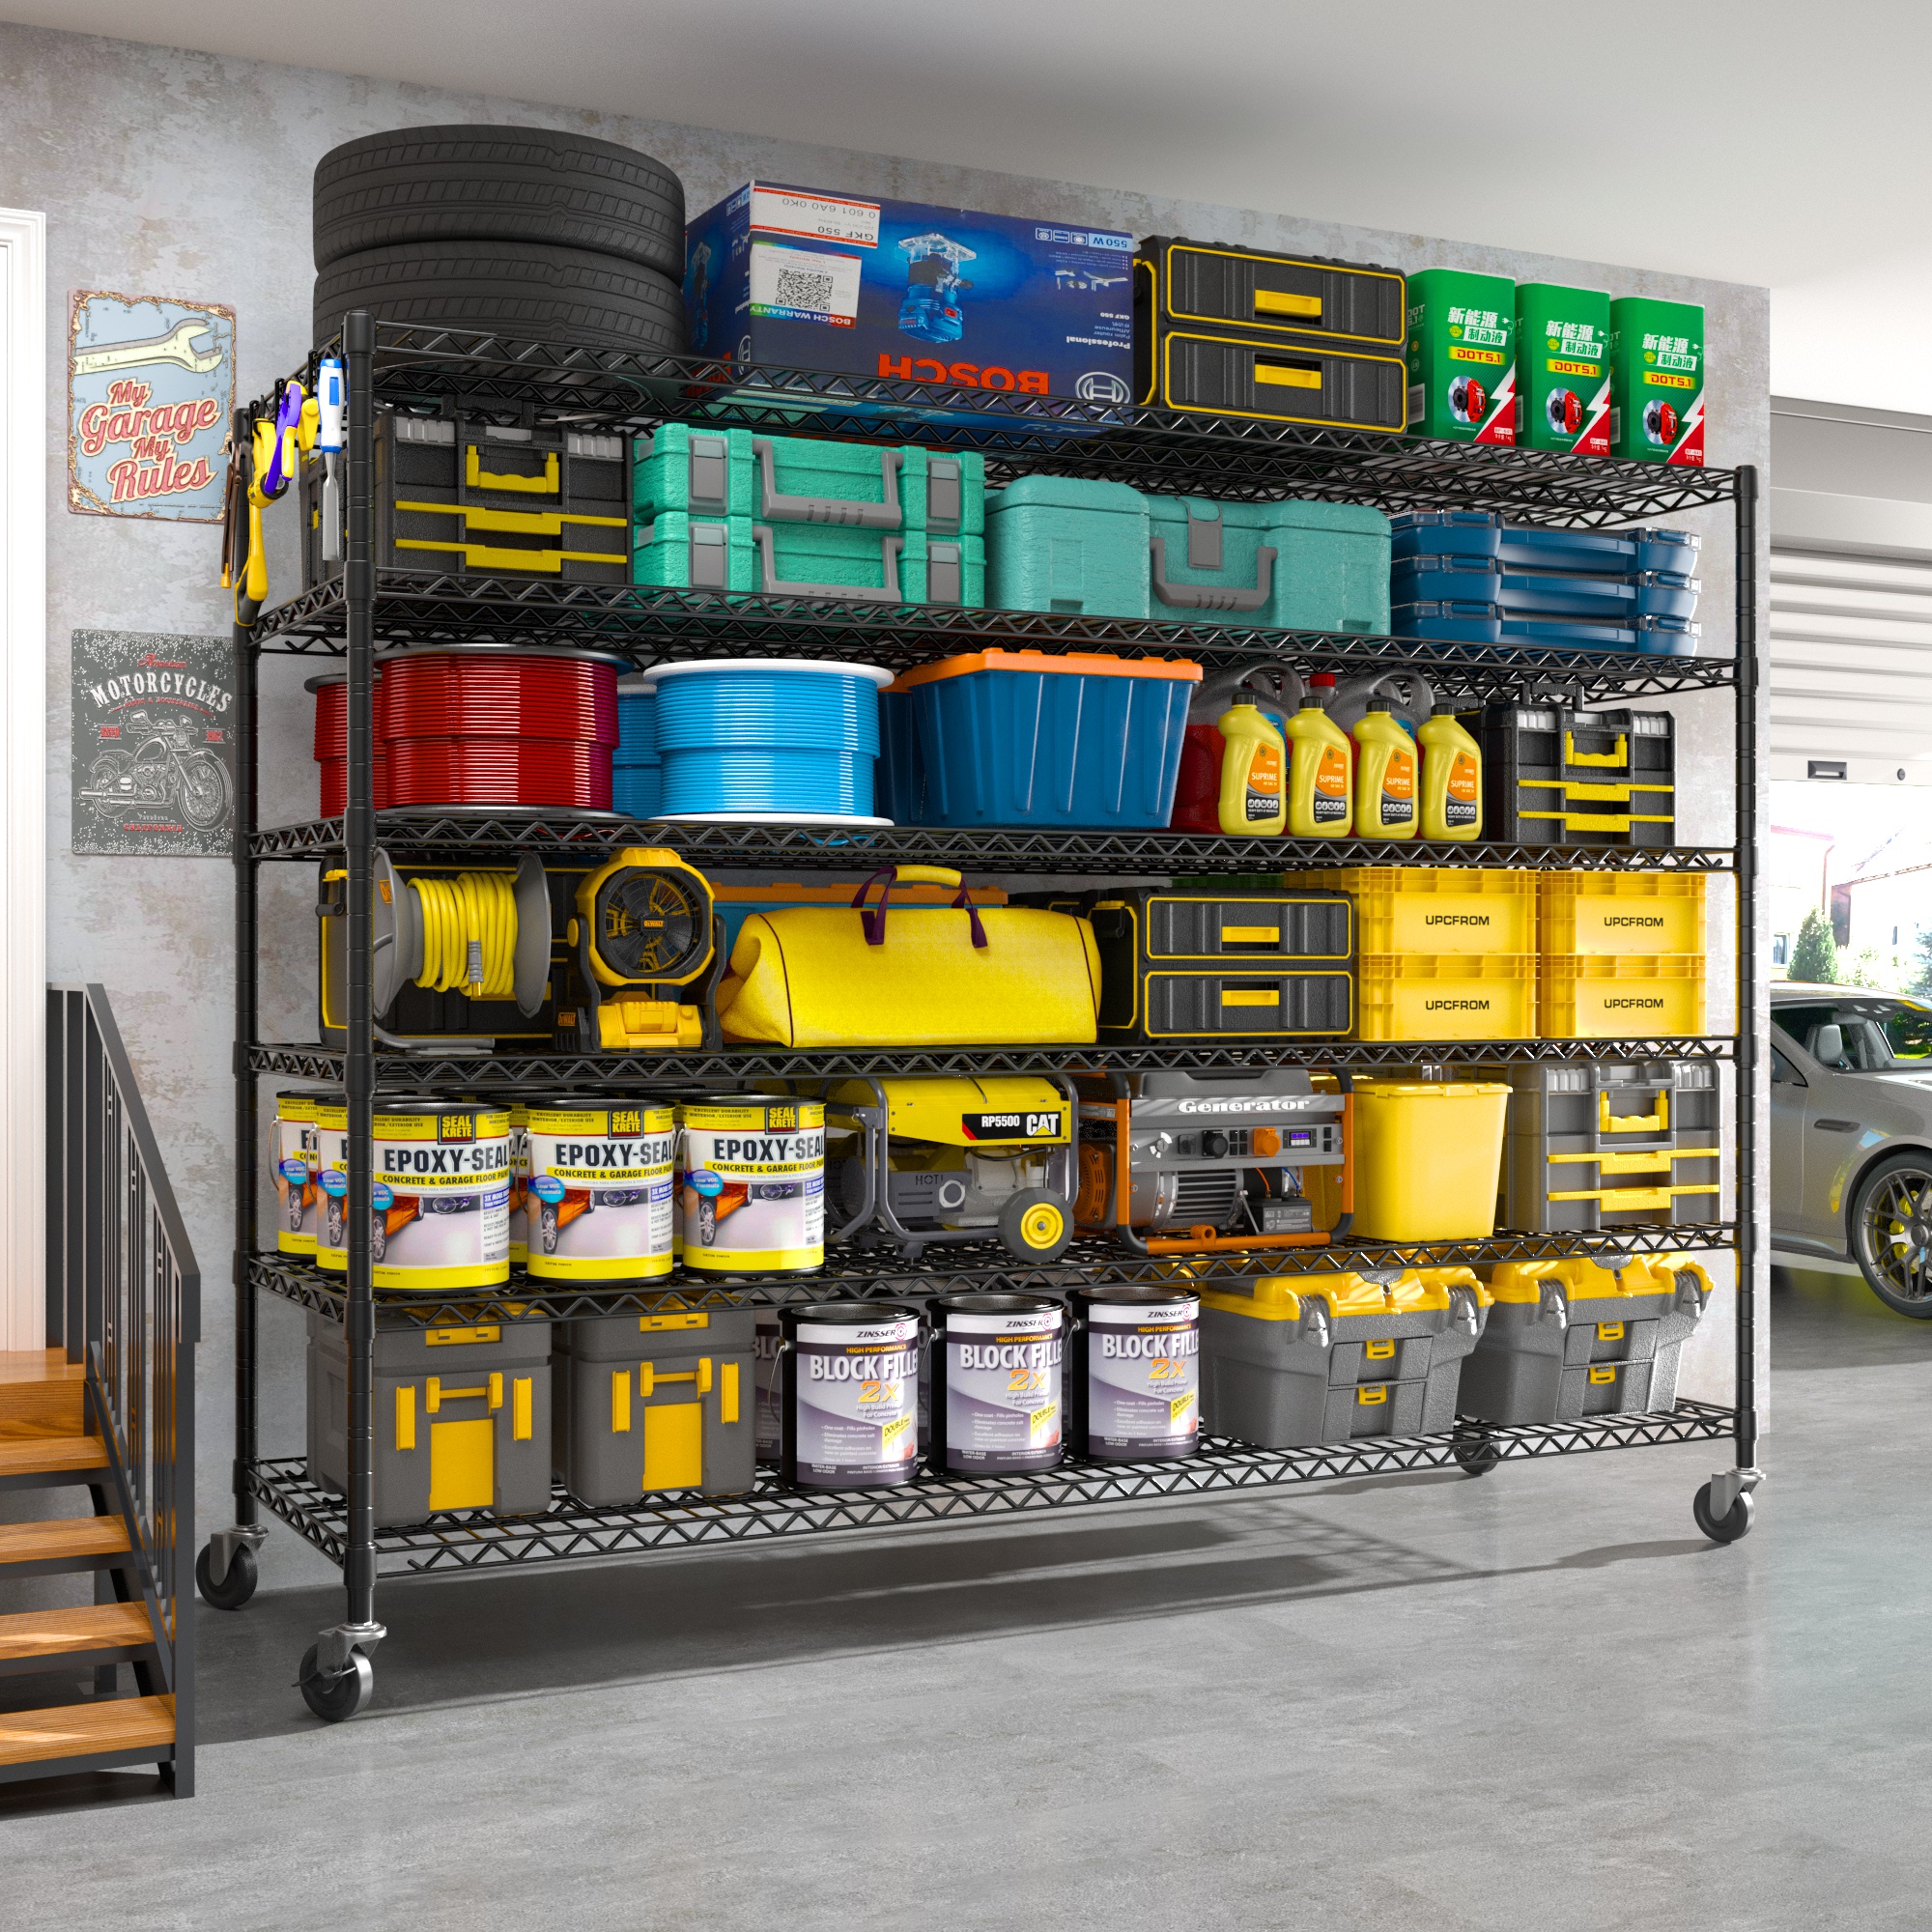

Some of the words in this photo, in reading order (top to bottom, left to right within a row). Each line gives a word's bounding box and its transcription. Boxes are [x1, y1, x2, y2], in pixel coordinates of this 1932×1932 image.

[811, 203, 837, 213] 6A0
[841, 208, 864, 216] 601
[817, 226, 840, 236] 550
[846, 231, 873, 241] GKF
[1106, 239, 1126, 248] 550
[750, 305, 810, 319] WARRANTY
[1447, 307, 1498, 328] 新能源
[813, 314, 851, 325] BOSCH
[1468, 328, 1503, 344] 制动液
[1546, 321, 1594, 341] 新能源
[1066, 336, 1130, 350] Professional
[1565, 342, 1599, 356] 制动液
[1642, 333, 1689, 354] 新能源
[1457, 349, 1500, 363] DOT5.1
[1662, 354, 1692, 369] 制动液
[878, 353, 1049, 395] BOSCH
[1554, 361, 1597, 375] DOT5.1
[1651, 374, 1690, 387] DOT5.1
[110, 381, 150, 406] My
[81, 400, 217, 454] Garage
[133, 437, 170, 462] My
[110, 456, 214, 500] Rules
[89, 671, 233, 713] MOTORCYCLES
[124, 823, 184, 833] CALIFORNIA
[1425, 916, 1490, 925] UPCFROM
[1604, 917, 1663, 927] UPCFROM
[1425, 1000, 1490, 1010] UPCFROM
[1604, 999, 1663, 1009] UPCFROM
[1177, 1097, 1311, 1113] Generator
[612, 1111, 640, 1122] SEAL
[769, 1107, 795, 1119] SEAL
[442, 1116, 471, 1127] SEAL
[612, 1122, 640, 1133] KRETE
[769, 1119, 795, 1128] KRETE
[981, 1115, 1020, 1128] RP5500
[1026, 1114, 1059, 1136] CAT
[442, 1127, 471, 1138] KRETE
[556, 1140, 672, 1167] EPOXY-SEAL
[714, 1135, 823, 1161] EPOXY-SEAL
[384, 1145, 508, 1173] EPOXY-SEAL
[554, 1169, 597, 1179] CONCRETE
[610, 1169, 642, 1178] GARAGE
[643, 1167, 662, 1176] FLOOR
[713, 1163, 753, 1172] CONCRETE
[767, 1163, 797, 1172] GARAGE
[799, 1161, 815, 1170] FLOOR
[383, 1175, 425, 1184] CONCRETE
[440, 1176, 473, 1185] GARAGE
[475, 1173, 497, 1182] FLOOR
[916, 1175, 944, 1185] HOT!
[856, 1329, 895, 1338] ZINSSER
[1102, 1333, 1168, 1358] BLOCK
[960, 1344, 1028, 1369] BLOCK
[810, 1355, 879, 1380] BLOCK
[884, 1418, 904, 1436] DOUBLE
